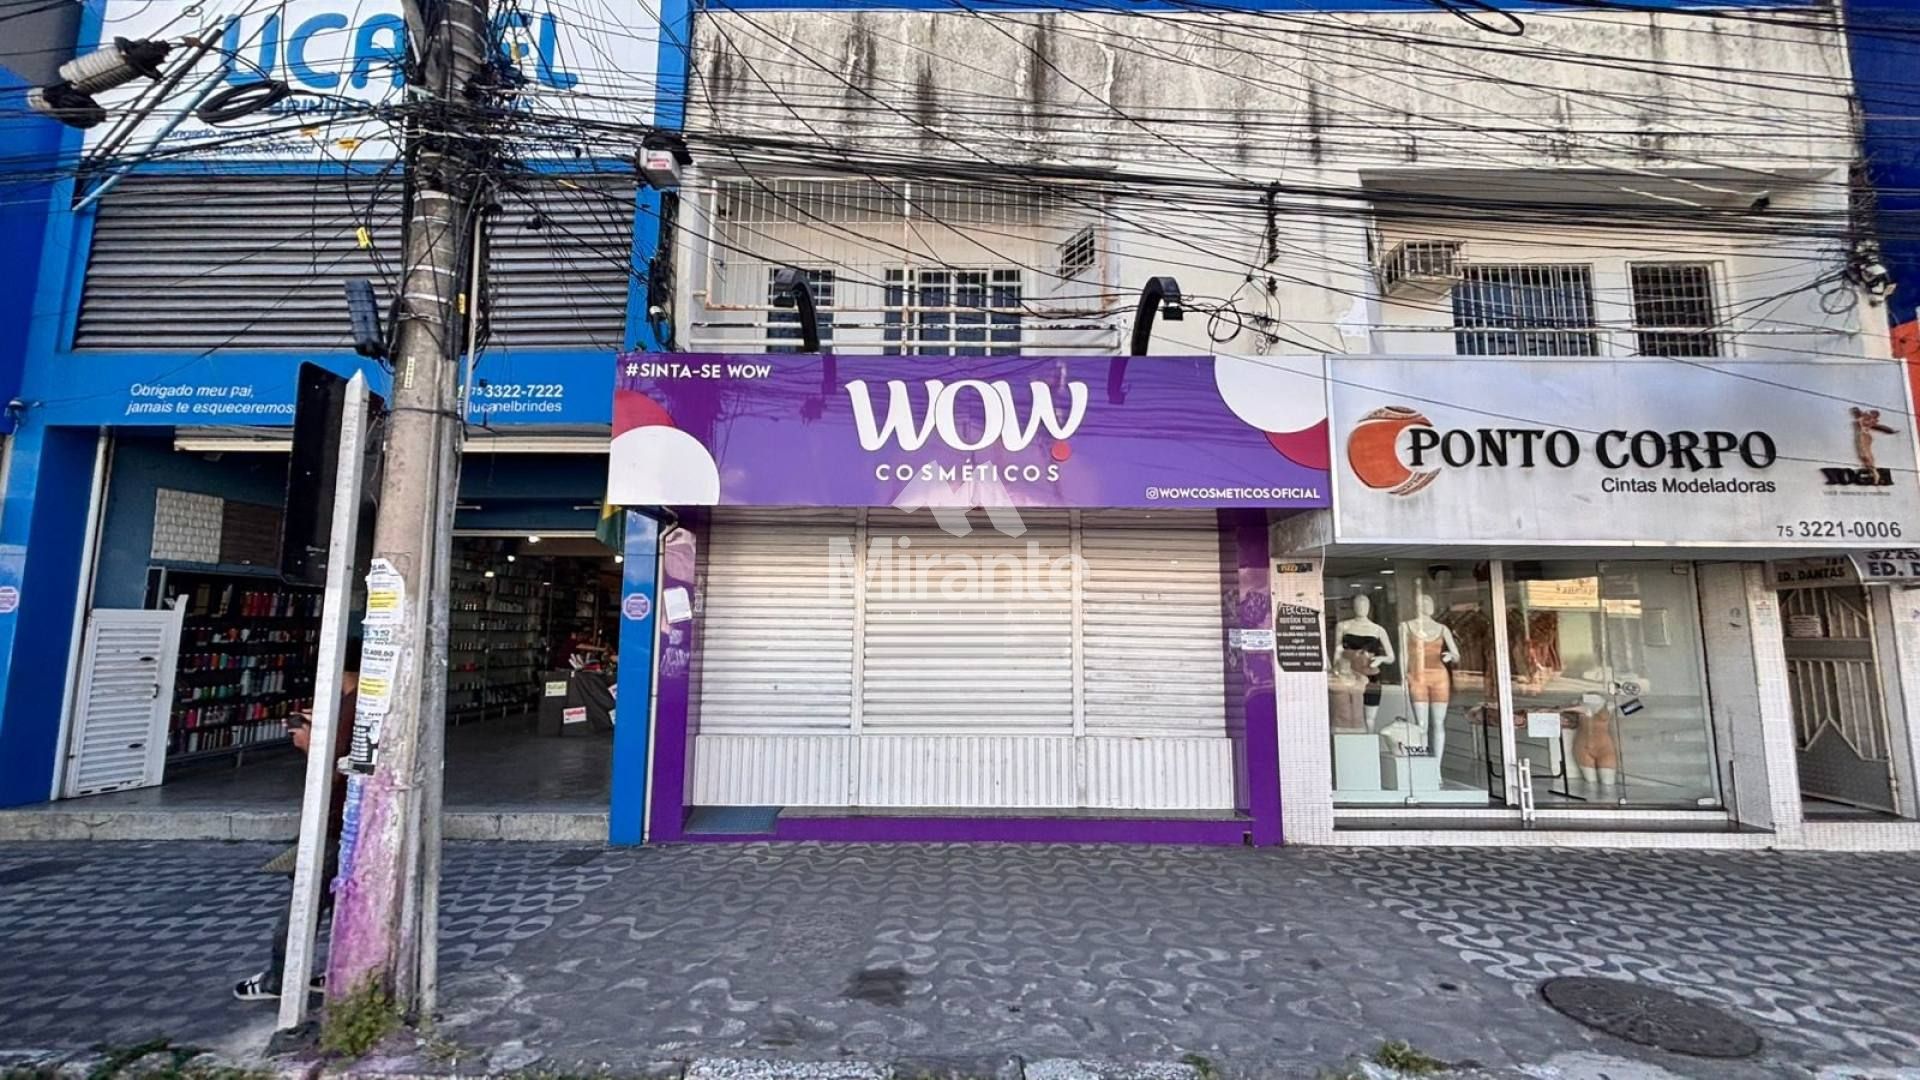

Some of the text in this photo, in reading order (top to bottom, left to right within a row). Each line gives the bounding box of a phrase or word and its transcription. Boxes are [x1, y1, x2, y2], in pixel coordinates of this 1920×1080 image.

[625, 363, 771, 379] #SINTA-SE WOW
[130, 383, 193, 399] Obrigado
[196, 386, 228, 397] meu
[484, 384, 564, 398] 3322-7222
[125, 400, 174, 416] jamais
[176, 401, 189, 413] te
[1407, 428, 1777, 472] PONTO CORPO
[875, 459, 1060, 482] COSMÉTICOS
[1601, 477, 1776, 493] Cintas Modeladoras
[1777, 520, 1902, 538] 75 3221-0006
[1867, 561, 1904, 577] ED.
